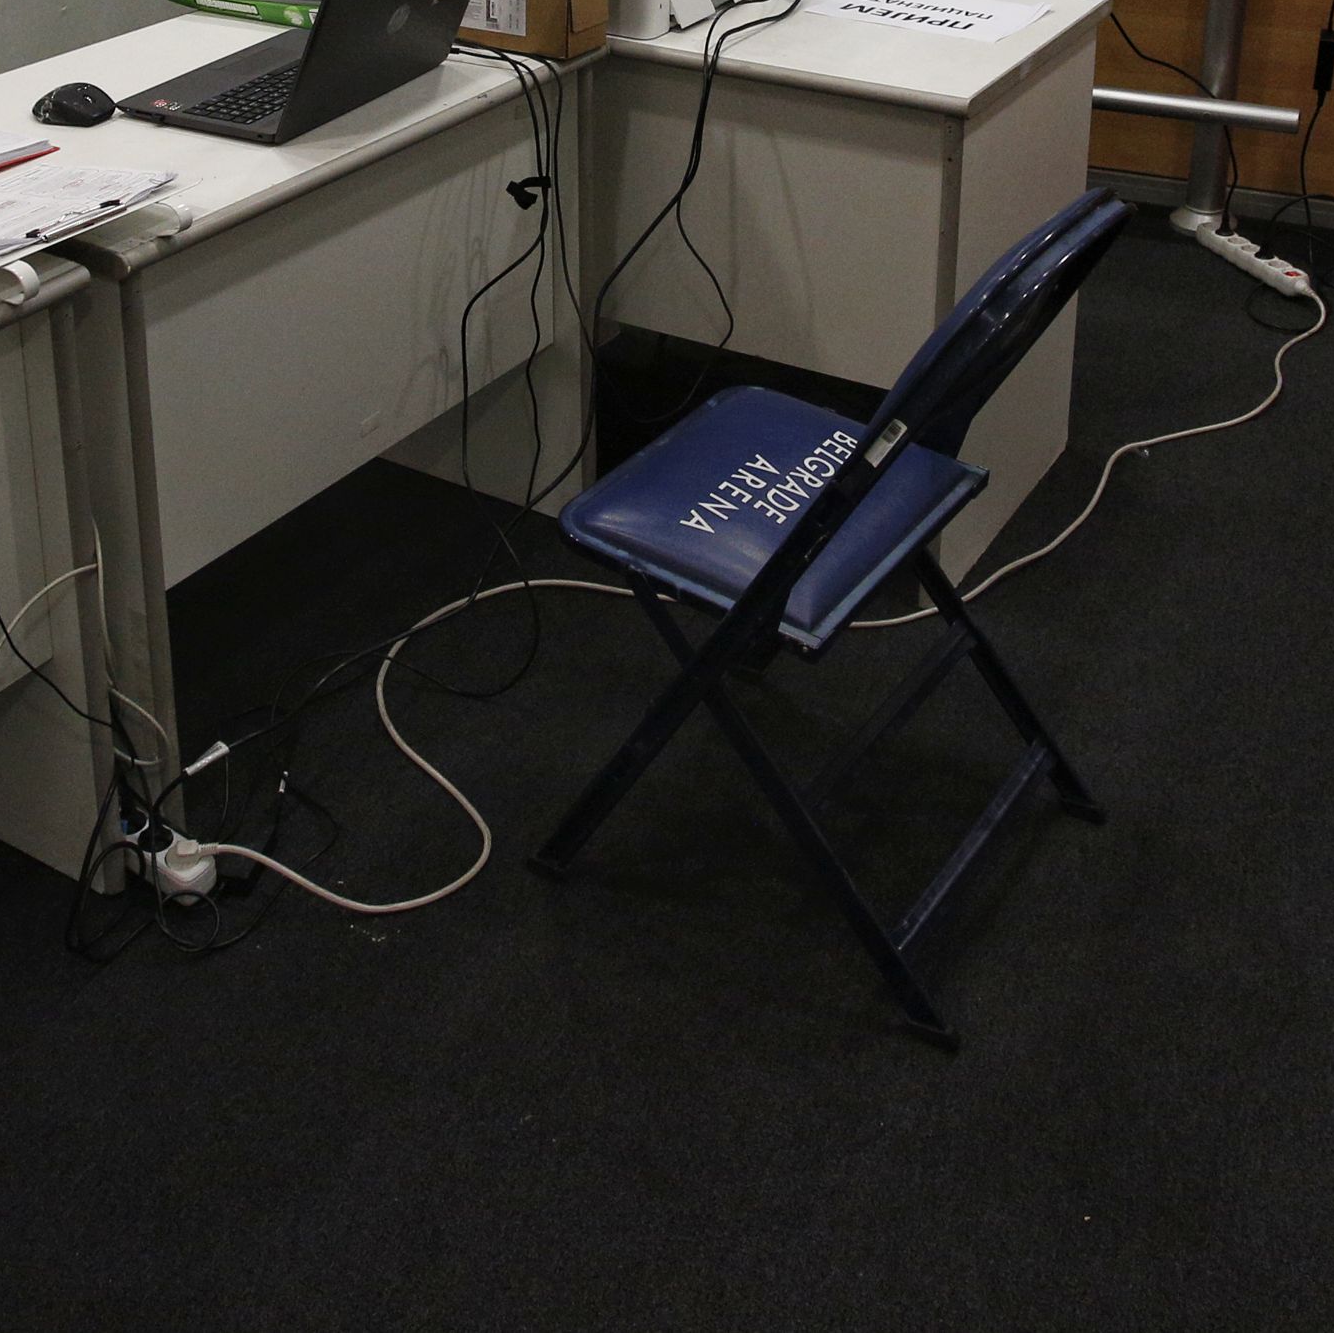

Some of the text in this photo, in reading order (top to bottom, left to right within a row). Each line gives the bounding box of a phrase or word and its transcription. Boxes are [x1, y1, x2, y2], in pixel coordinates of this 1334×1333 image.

[839, 2, 976, 32] ПРИЈЕМ
[679, 453, 781, 535] ARENA
[753, 429, 859, 525] BELGRADE
